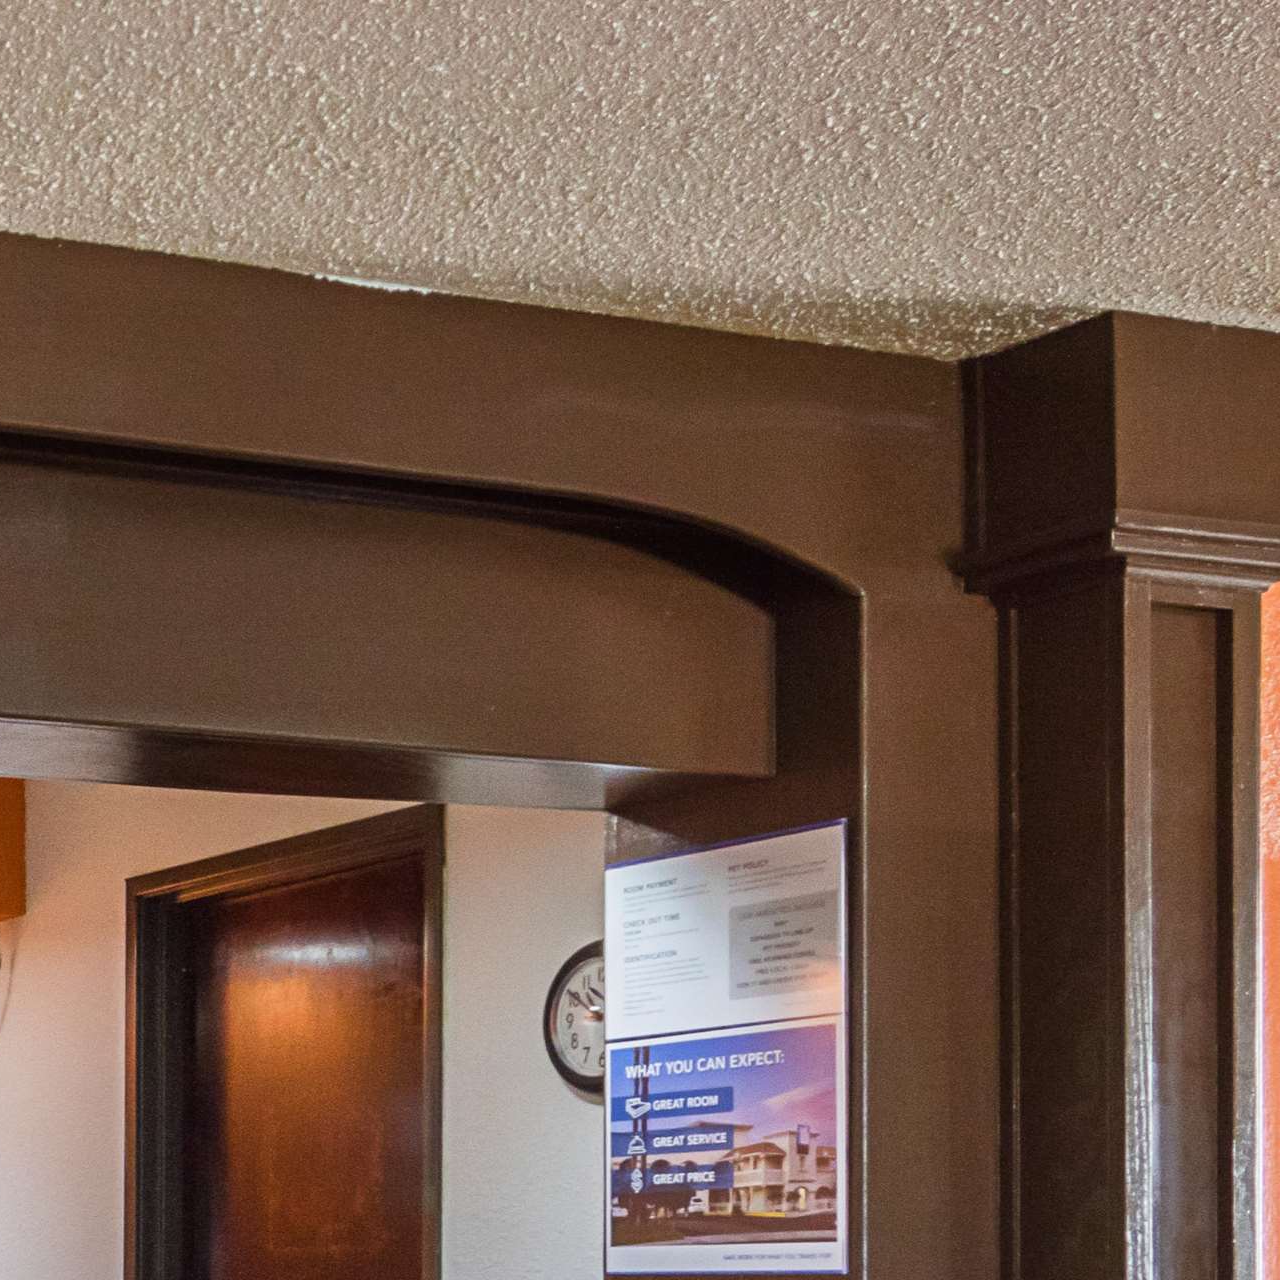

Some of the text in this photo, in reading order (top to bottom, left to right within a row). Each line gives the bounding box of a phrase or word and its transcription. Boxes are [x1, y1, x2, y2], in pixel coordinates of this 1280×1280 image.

[565, 1013, 574, 1029] 9
[570, 1033, 578, 1049] 8
[583, 1046, 591, 1063] 7
[625, 1050, 785, 1079] WHAT YOU CAN EXPECT:
[652, 1095, 719, 1111] GREAT ROOM
[652, 1132, 727, 1148] GREAT SERVICE
[652, 1171, 716, 1185] GREAT PRICE
